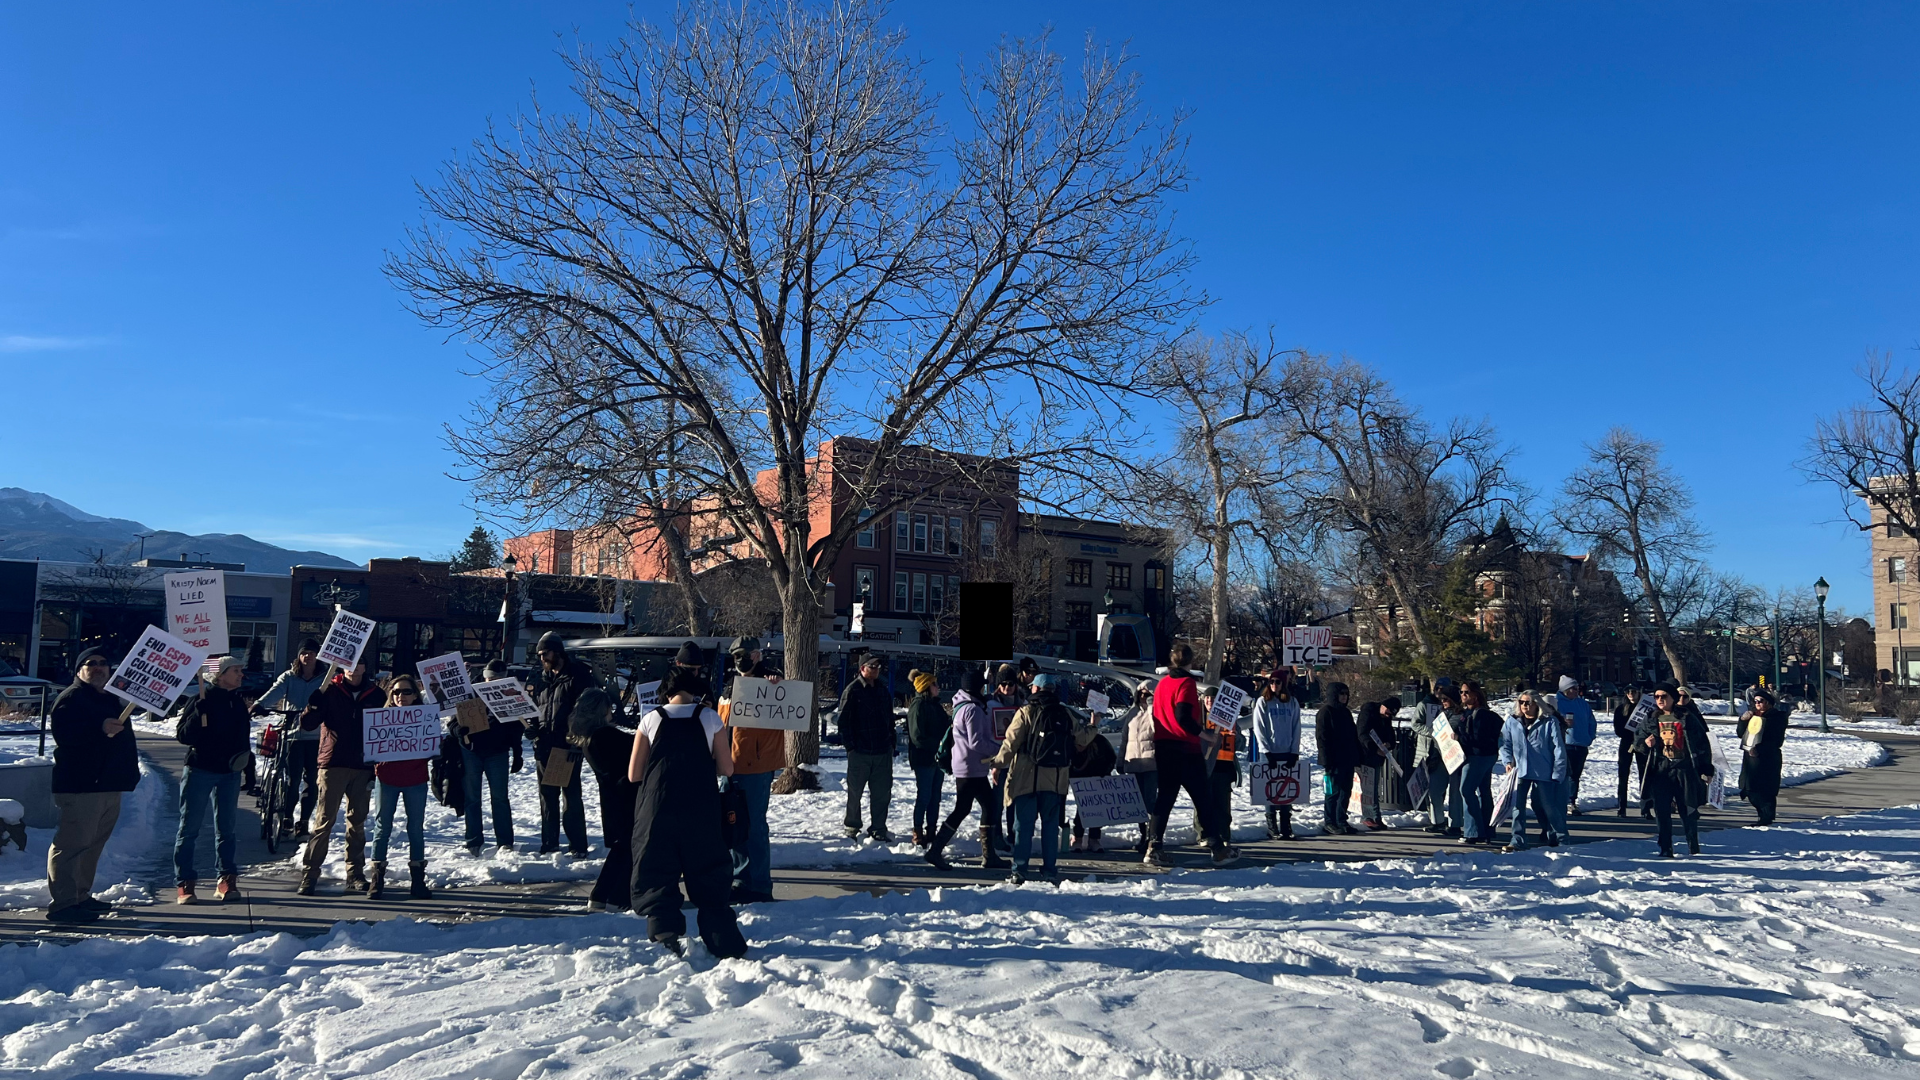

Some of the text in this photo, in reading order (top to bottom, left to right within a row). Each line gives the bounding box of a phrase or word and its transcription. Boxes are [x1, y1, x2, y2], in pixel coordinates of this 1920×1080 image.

[171, 577, 216, 588] KRISTY NOEM
[181, 591, 204, 600] LIED
[175, 613, 211, 624] WE ALL
[338, 614, 371, 632] JUSTICE
[341, 625, 360, 635] FOR
[1284, 628, 1332, 647] DEFUND
[329, 636, 347, 647] KILLED
[145, 637, 192, 665] END CSPD
[333, 647, 343, 655] ICE
[138, 648, 179, 672] & EPCSO
[131, 658, 182, 688] COLLUSION
[423, 663, 446, 675] JUSTICE
[440, 667, 460, 680] RENEE
[124, 667, 169, 695] WITH ICE!
[441, 676, 465, 689] NICOLE
[447, 686, 465, 697] GOOD
[482, 691, 503, 701] 719
[756, 686, 786, 701] NO
[1221, 684, 1243, 702] KILLER
[733, 701, 806, 719] GESTAPO
[1218, 695, 1238, 710] ICE
[366, 709, 422, 725] TRUMP
[434, 714, 440, 722] A
[1212, 707, 1233, 722] STREETS
[368, 724, 435, 740] DOMESTIC
[366, 736, 440, 755] TERRORIST
[1252, 763, 1301, 780] CRUSH
[1096, 778, 1120, 790] TAKE
[1121, 777, 1137, 789] MY
[1266, 780, 1299, 801] ICE
[1077, 792, 1141, 807] WHISKEY NEAT
[1106, 807, 1125, 820] ICE
